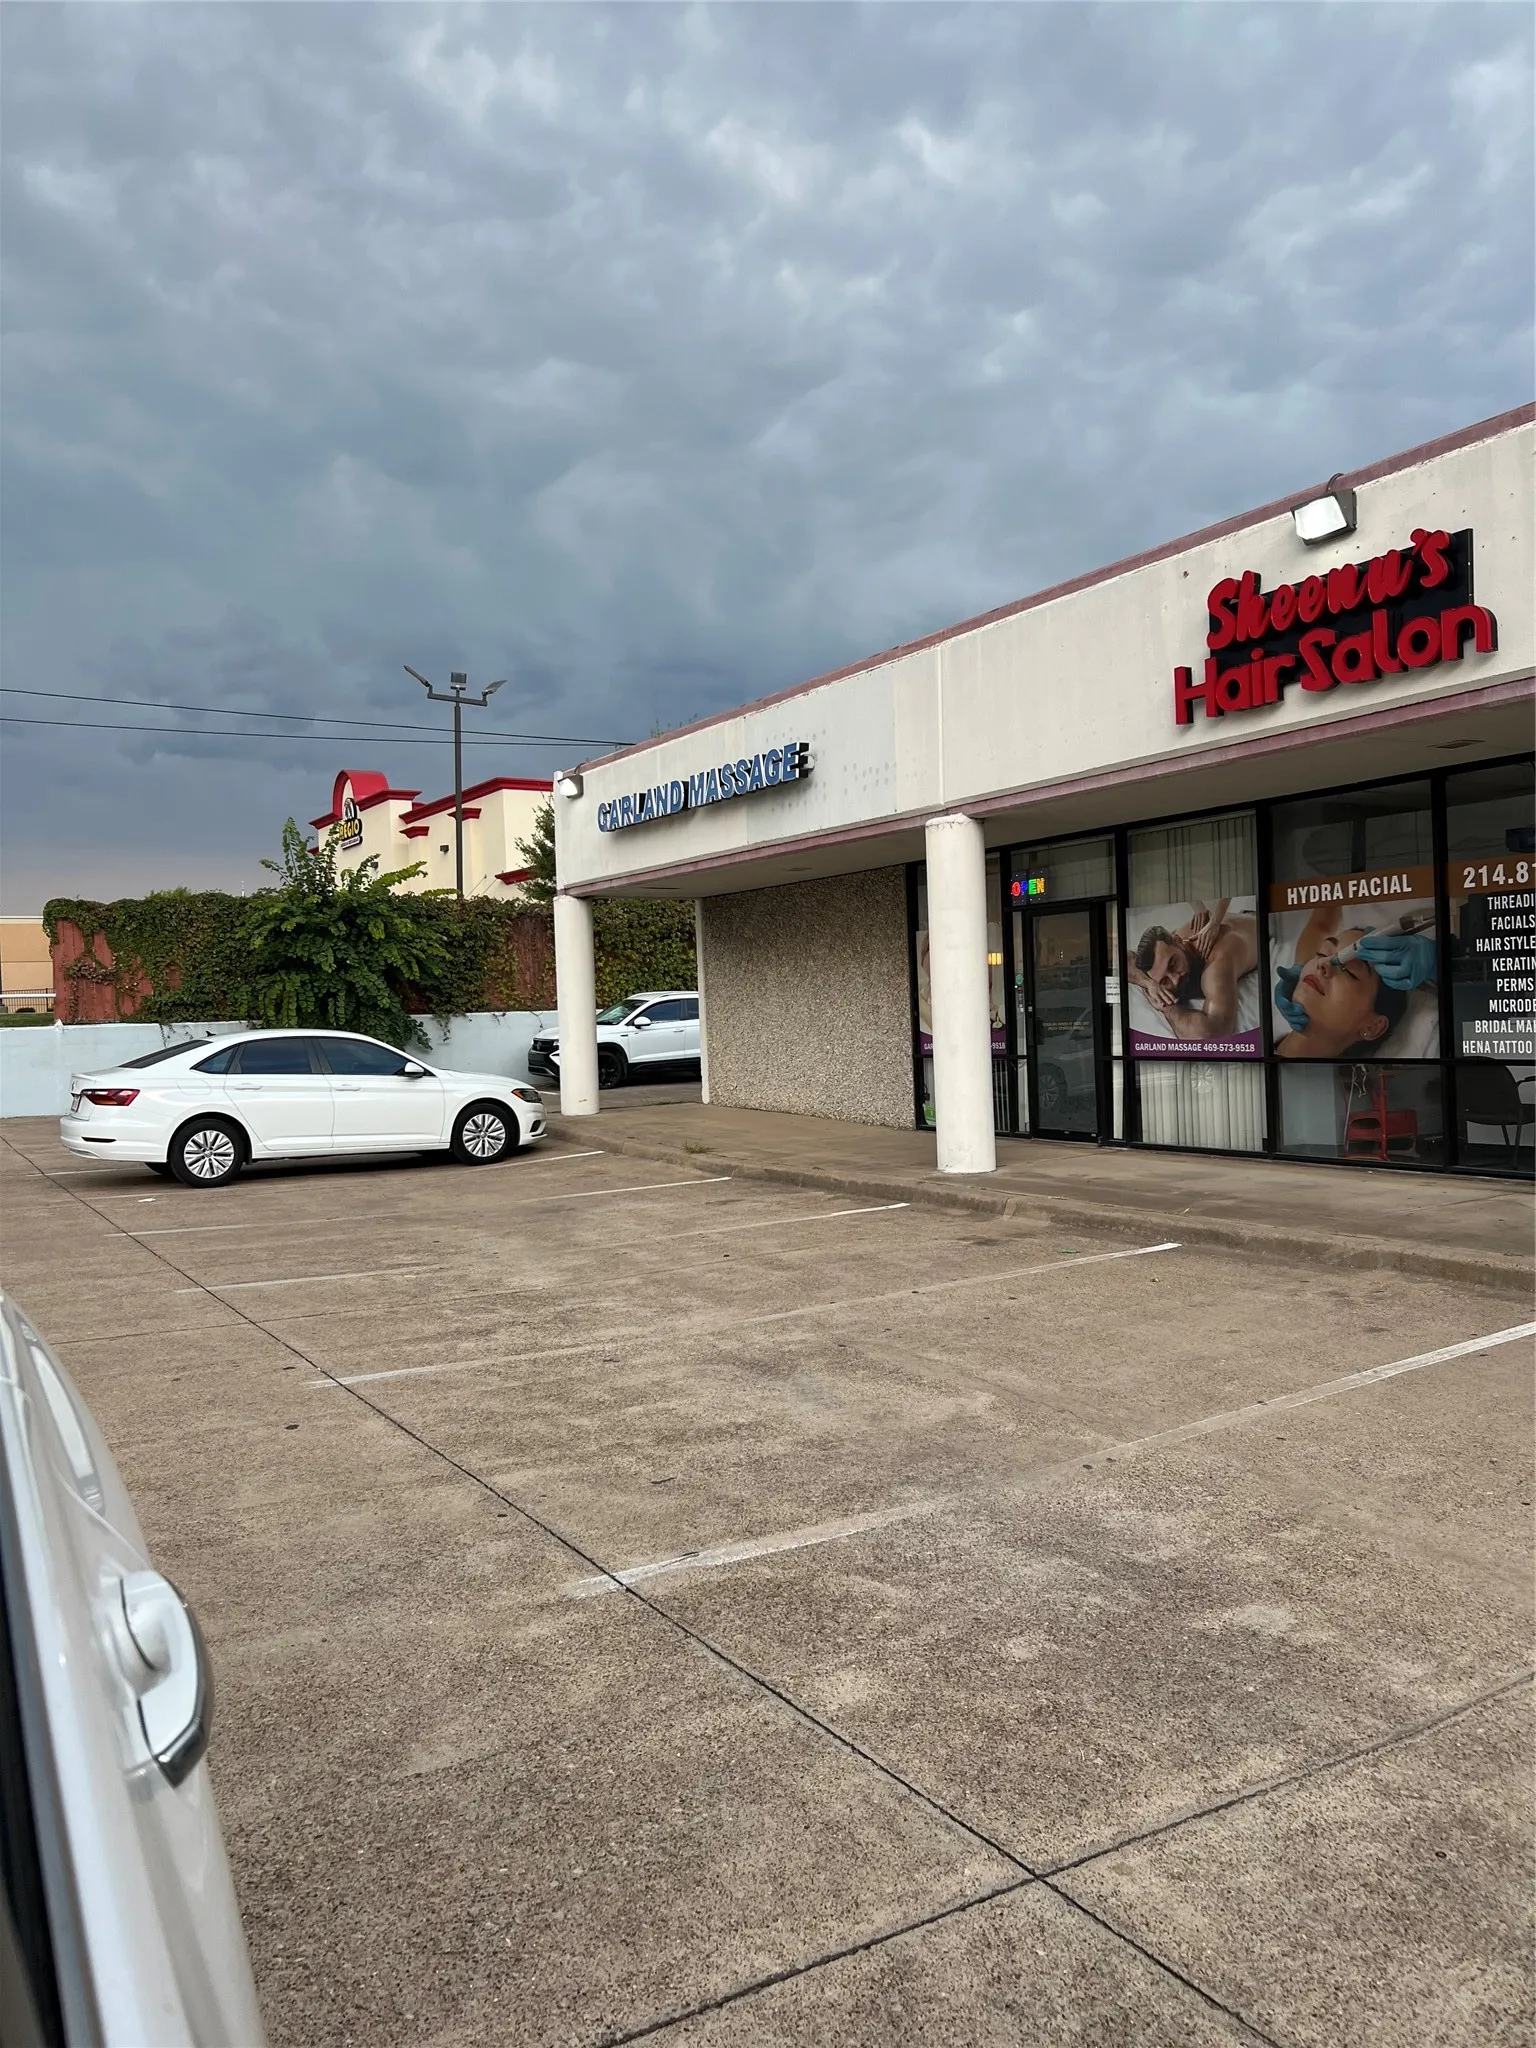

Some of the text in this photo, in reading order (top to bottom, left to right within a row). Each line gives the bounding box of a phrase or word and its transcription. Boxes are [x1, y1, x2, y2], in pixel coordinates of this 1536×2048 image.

[1207, 528, 1450, 649] Sheenu's
[1174, 604, 1497, 725] Hair Salon
[597, 742, 802, 832] GARLAND MASSAGE
[1011, 877, 1046, 897] OPEN
[1287, 874, 1412, 905] HYDRA FACIAL
[1491, 914, 1536, 930] FACIALS
[1476, 937, 1502, 952] HAIR
[1497, 977, 1534, 992] PERMS
[1475, 1019, 1514, 1034] BRIDAL
[1135, 1043, 1255, 1053] GARLAND MASSAGE 469-573-9518
[1462, 1040, 1533, 1054] HENA TATTOO
